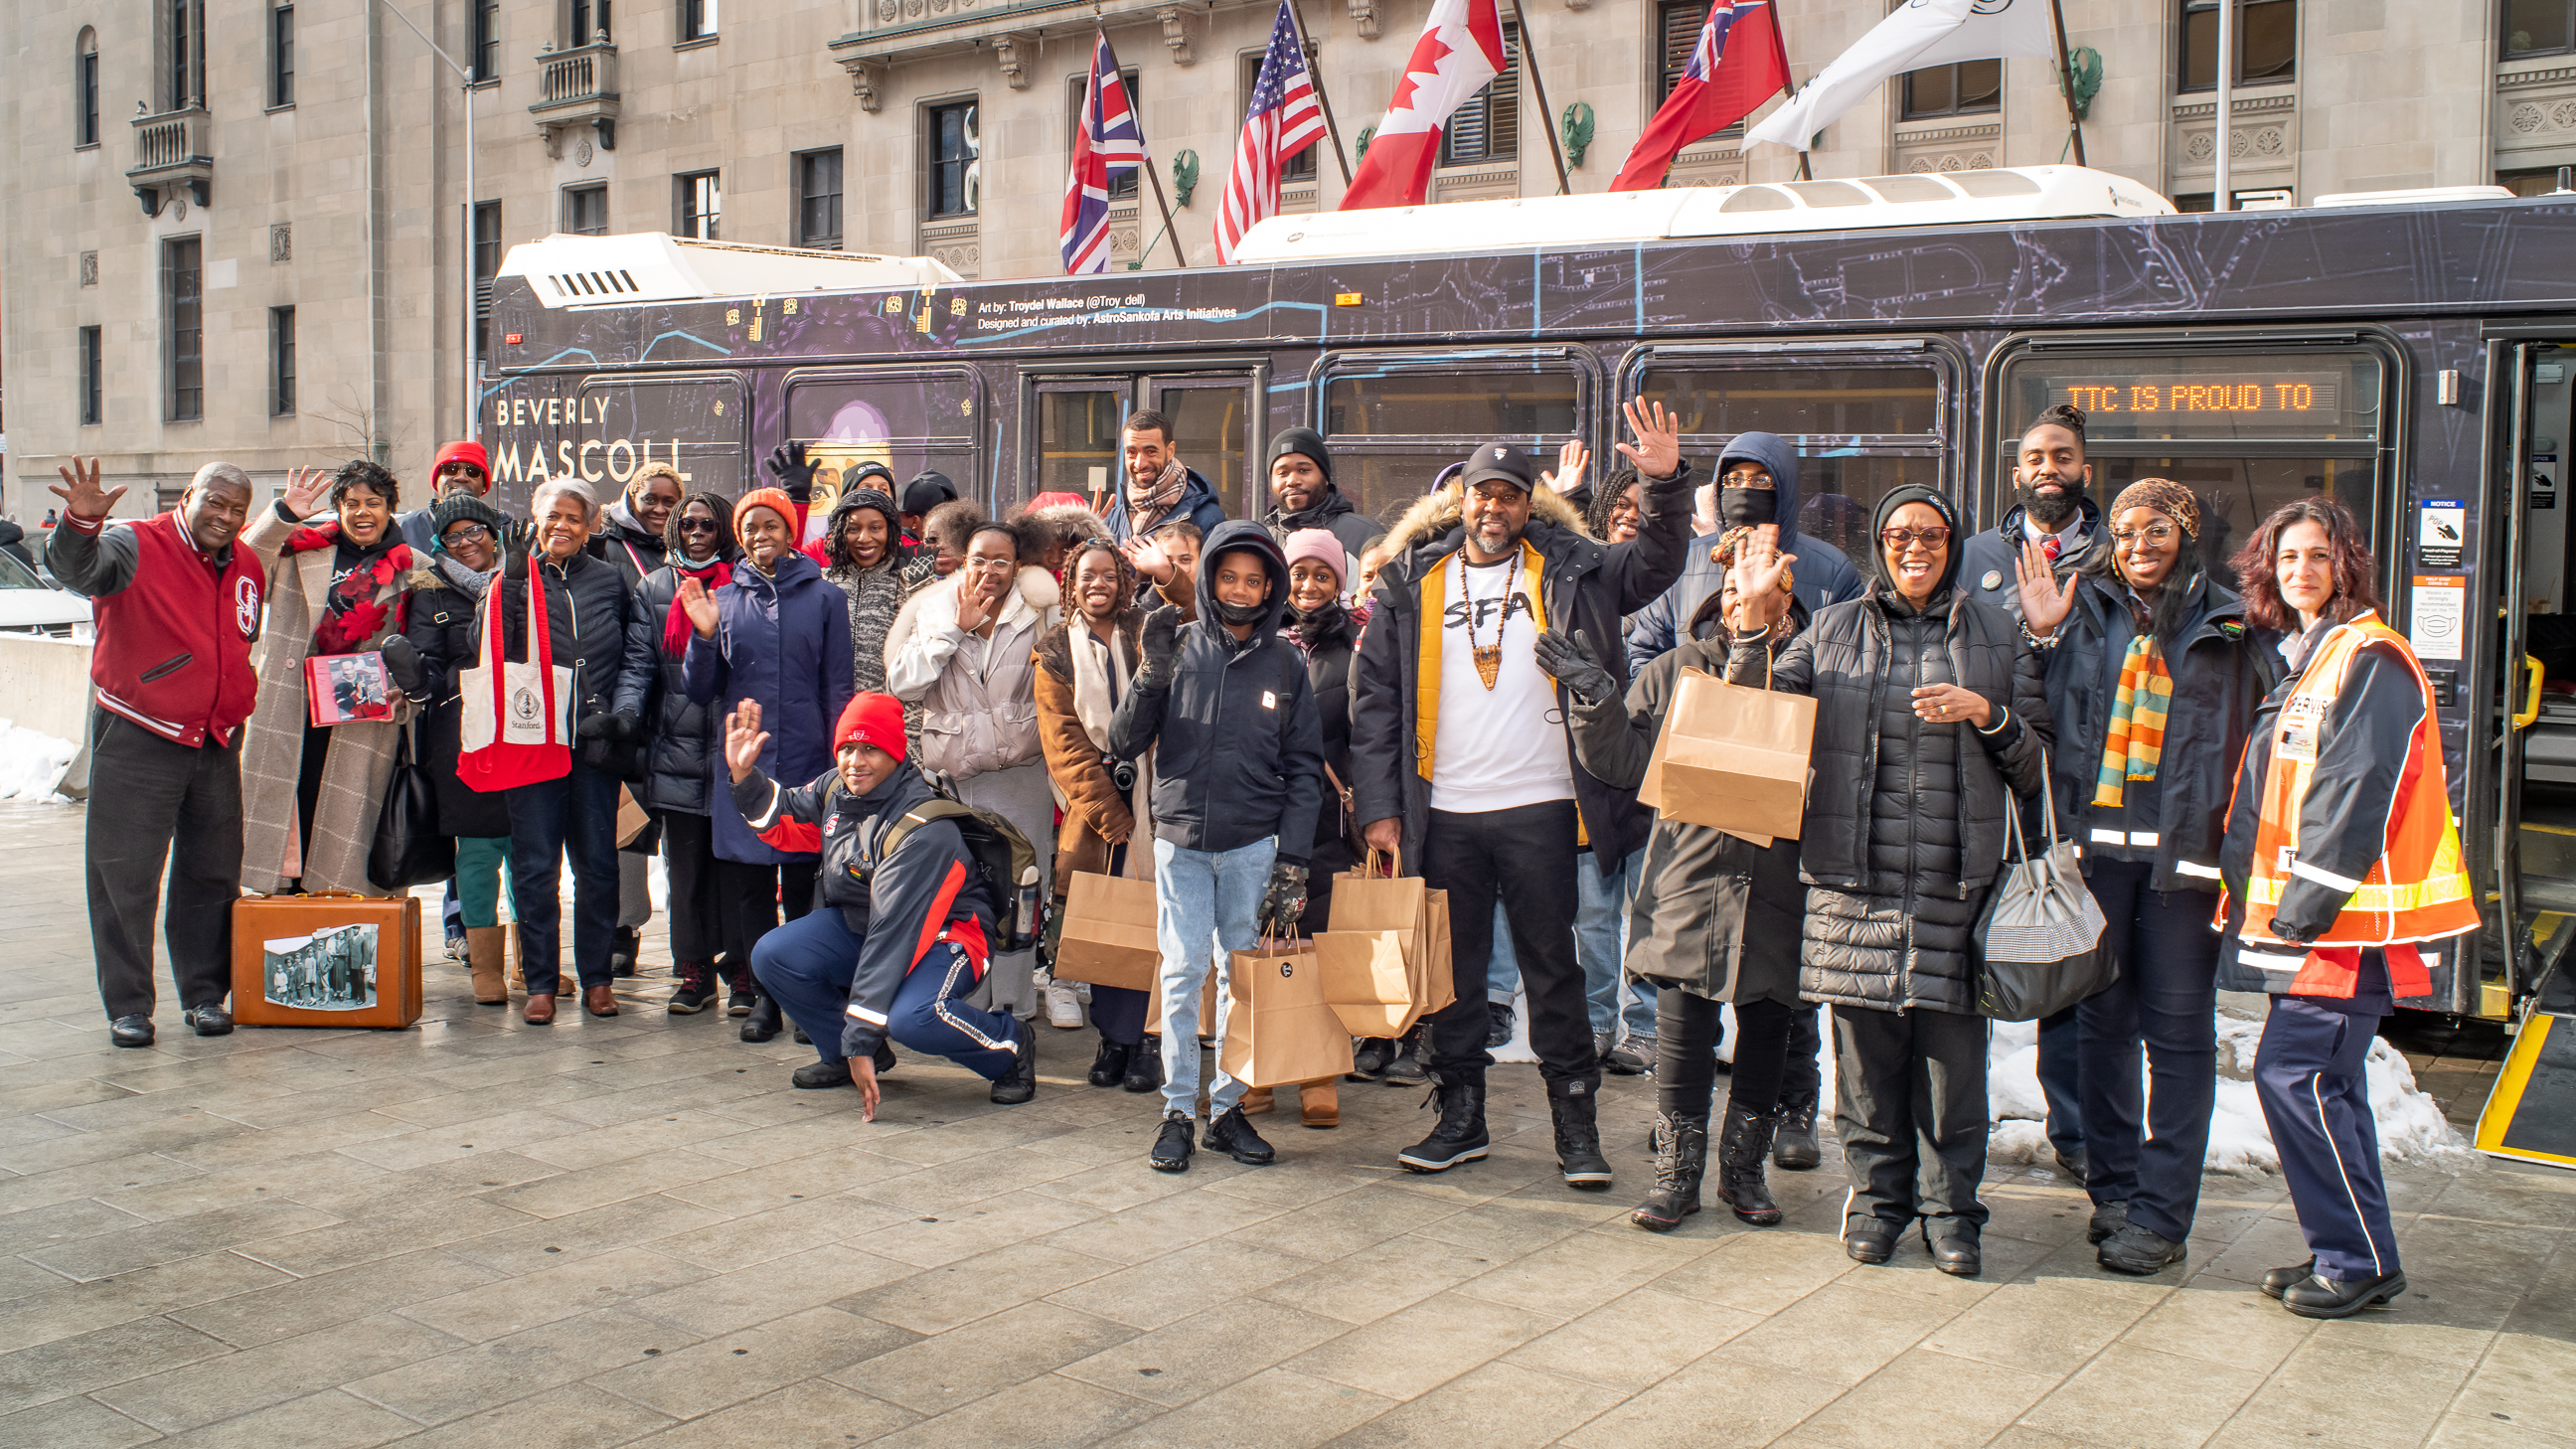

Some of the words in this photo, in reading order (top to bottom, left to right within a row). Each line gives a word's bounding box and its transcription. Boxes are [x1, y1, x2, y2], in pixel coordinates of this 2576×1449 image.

[978, 302, 992, 313] Art
[993, 301, 1007, 313] by:
[1009, 299, 1045, 312] Troydel
[1046, 298, 1084, 310] Wallace
[1086, 294, 1146, 309] (@Troy_dell)
[978, 317, 1020, 331] Designed
[1021, 316, 1039, 328] and
[1040, 315, 1074, 326] curated
[1075, 314, 1091, 326] by:
[1093, 310, 1160, 324] AstroSankofa
[1162, 309, 1184, 321] Arts
[1186, 307, 1237, 320] Initiatives
[2067, 386, 2118, 411] TTC
[2130, 386, 2159, 411] IS
[2171, 385, 2261, 411] PROUD
[2275, 384, 2312, 410] TO
[497, 396, 610, 426] BEVERLY
[1444, 592, 1535, 629] SFA
[512, 720, 541, 729] Stanford
